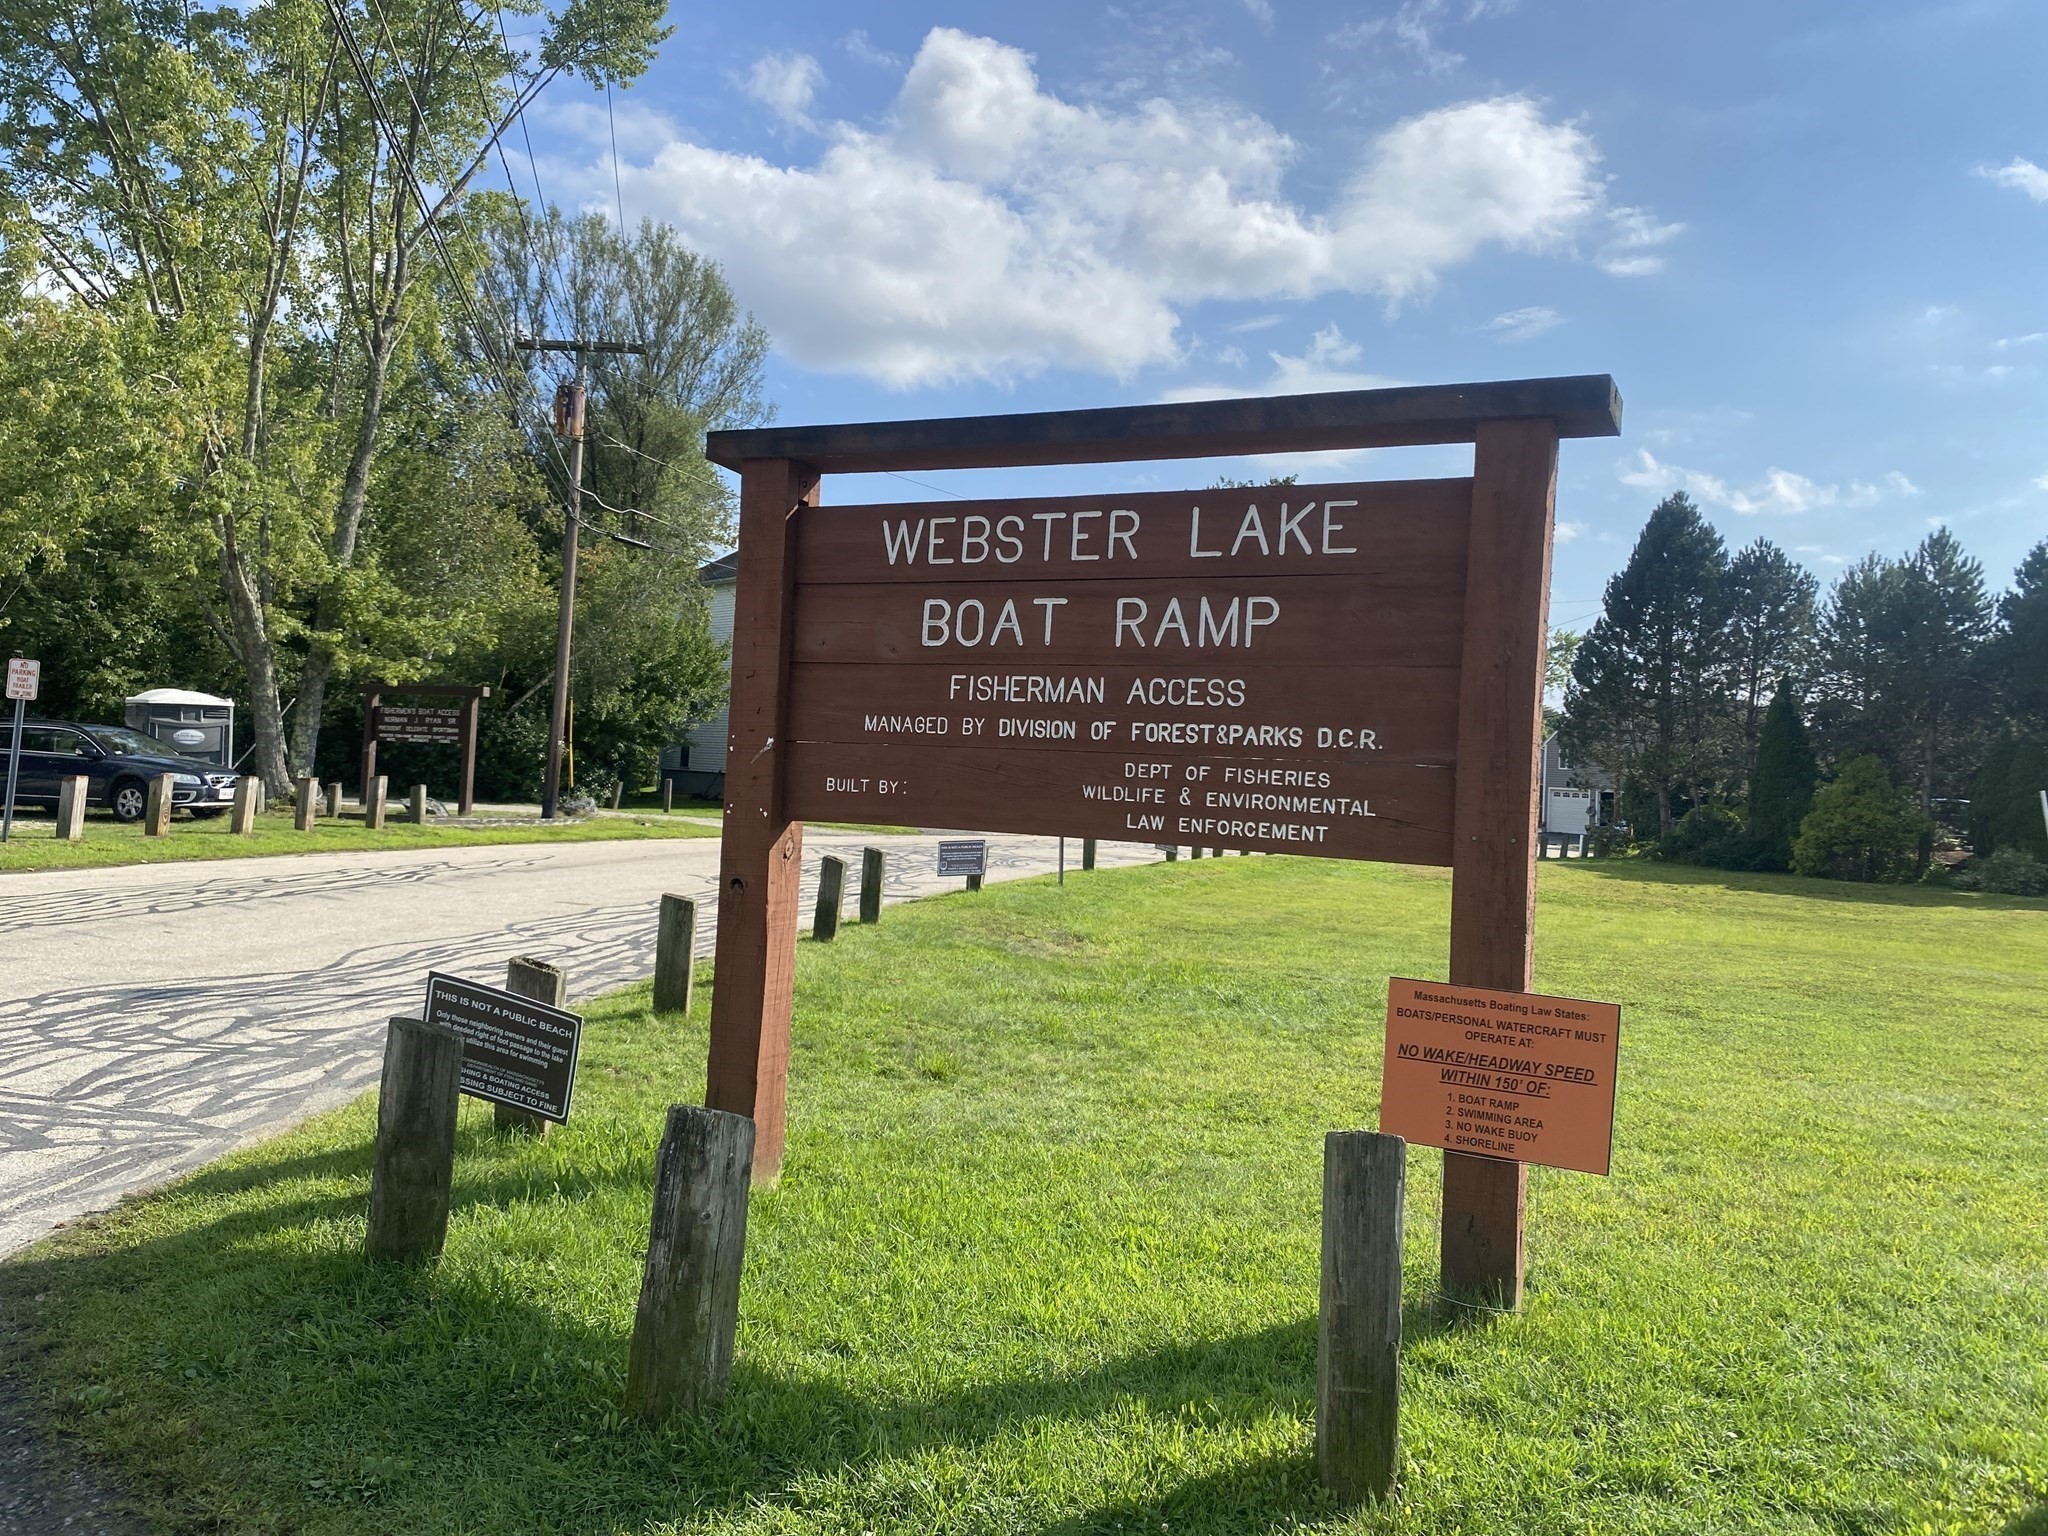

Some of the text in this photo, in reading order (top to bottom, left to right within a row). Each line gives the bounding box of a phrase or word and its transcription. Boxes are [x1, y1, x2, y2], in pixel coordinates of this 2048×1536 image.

[882, 500, 1359, 565] WEBSTER LAKE
[921, 596, 1280, 648] BOAT RAMP
[12, 669, 36, 677] PARKING
[950, 674, 1246, 707] FISHERMAN ACCESS
[864, 714, 1384, 750] MANAGED BY DIVISION OF FOREST&PARKS D.C.R.
[826, 777, 908, 796] BUILT BY:
[1124, 762, 1331, 789] DEPT OF FISHERIES
[1082, 784, 1377, 818] WILDLIFE & ENVIRONMENTAL
[1126, 813, 1329, 843] LAW ENFORCEMENT
[436, 990, 572, 1038] THIS IS NOT A PUBLIC BEACH
[1414, 990, 1590, 1021] Massachusetts Boating Law States:
[436, 1010, 568, 1056] Only those neighboring owners and their guest
[1396, 1007, 1606, 1043] BOATS/PERSONAL WATERCRAFT MUST
[1465, 1031, 1534, 1049] OPERATE AT:
[453, 1025, 474, 1035] deeded
[475, 1031, 489, 1040] right
[497, 1036, 509, 1045] foot
[509, 1042, 533, 1053] passage
[541, 1051, 550, 1059] the
[552, 1054, 563, 1063] lake
[466, 1037, 548, 1069] utilize this area for swimming
[1398, 1043, 1595, 1081] NO WAKE/HEADWAY SPEED
[489, 1075, 520, 1089] BOATING
[521, 1086, 550, 1099] ACCESS
[1441, 1068, 1491, 1087] WITHIN
[1526, 1080, 1551, 1095] OF:
[487, 1084, 525, 1100] SUBJECT
[526, 1097, 538, 1106] TO
[540, 1102, 558, 1113] FINE
[1447, 1092, 1520, 1111] 1. BOAT RAMP
[1445, 1120, 1538, 1143] 3. NO WAKE BUOY
[1446, 1106, 1543, 1130] 2. SWIMMING AREA
[1444, 1134, 1515, 1153] 4. SHORELINE
